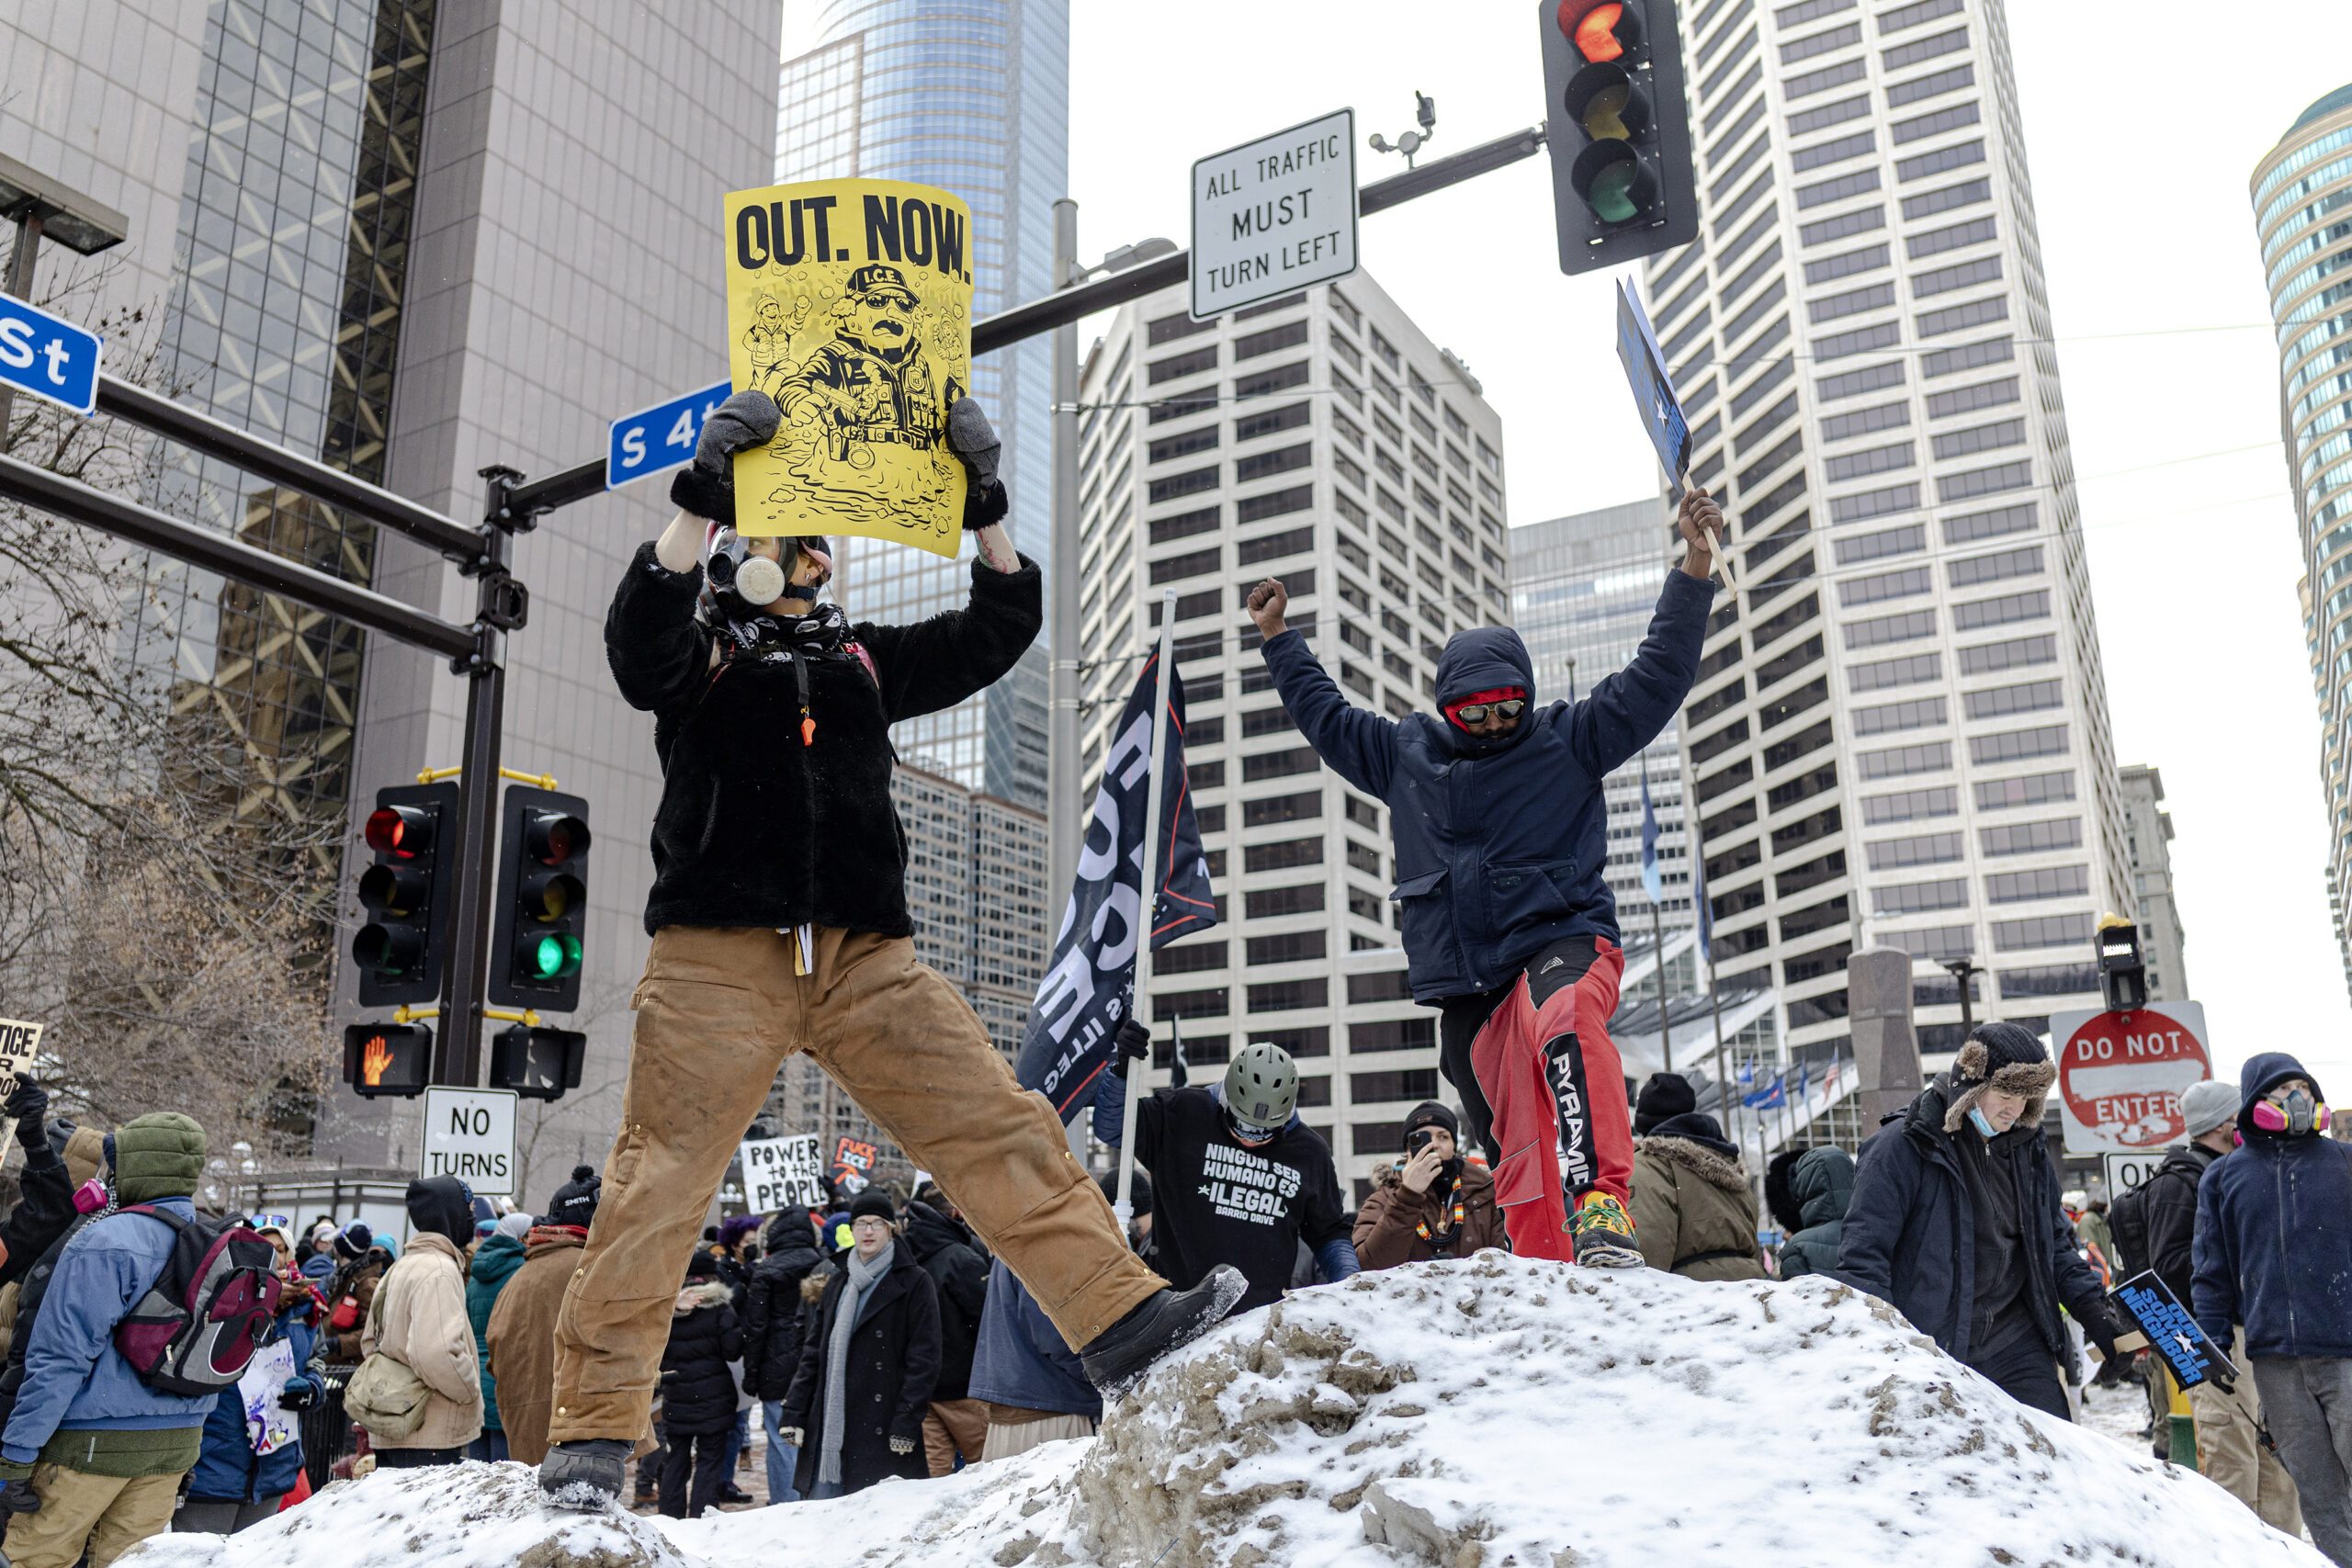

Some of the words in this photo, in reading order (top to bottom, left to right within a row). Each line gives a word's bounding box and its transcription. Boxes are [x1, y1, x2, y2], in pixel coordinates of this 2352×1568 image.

[1206, 169, 1242, 200] ALL
[1257, 135, 1339, 183] TRAFFIC
[1232, 188, 1313, 242] MUST
[736, 195, 850, 270] OUT.
[863, 194, 971, 286] NOW.
[864, 268, 900, 284] I.C.E.
[1207, 253, 1269, 293] TURN
[1283, 231, 1340, 271] LEFT
[0, 317, 70, 386] St
[621, 426, 647, 468] S
[2076, 1036, 2113, 1061] DO
[2126, 1031, 2181, 1057] NOT
[451, 1107, 491, 1136] NO
[2095, 1095, 2181, 1122] ENTER
[430, 1152, 508, 1178] TURNS
[751, 1139, 820, 1167] POWER
[768, 1165, 786, 1180] to
[791, 1161, 819, 1178] the
[835, 1136, 877, 1170] FUCK
[842, 1150, 868, 1170] ICE
[1204, 1143, 1269, 1171] NINGUN
[1272, 1161, 1302, 1186] SER
[1203, 1159, 1277, 1190] HUMANO
[1278, 1178, 1299, 1199] ES
[564, 1195, 590, 1207] SMITH
[1208, 1181, 1286, 1218] ILEGAL
[1215, 1205, 1249, 1221] BARRIO
[1250, 1213, 1275, 1226] DRIVE
[2118, 1285, 2203, 1384] NEIGHBOR
[2167, 1303, 2204, 1344] OUR
